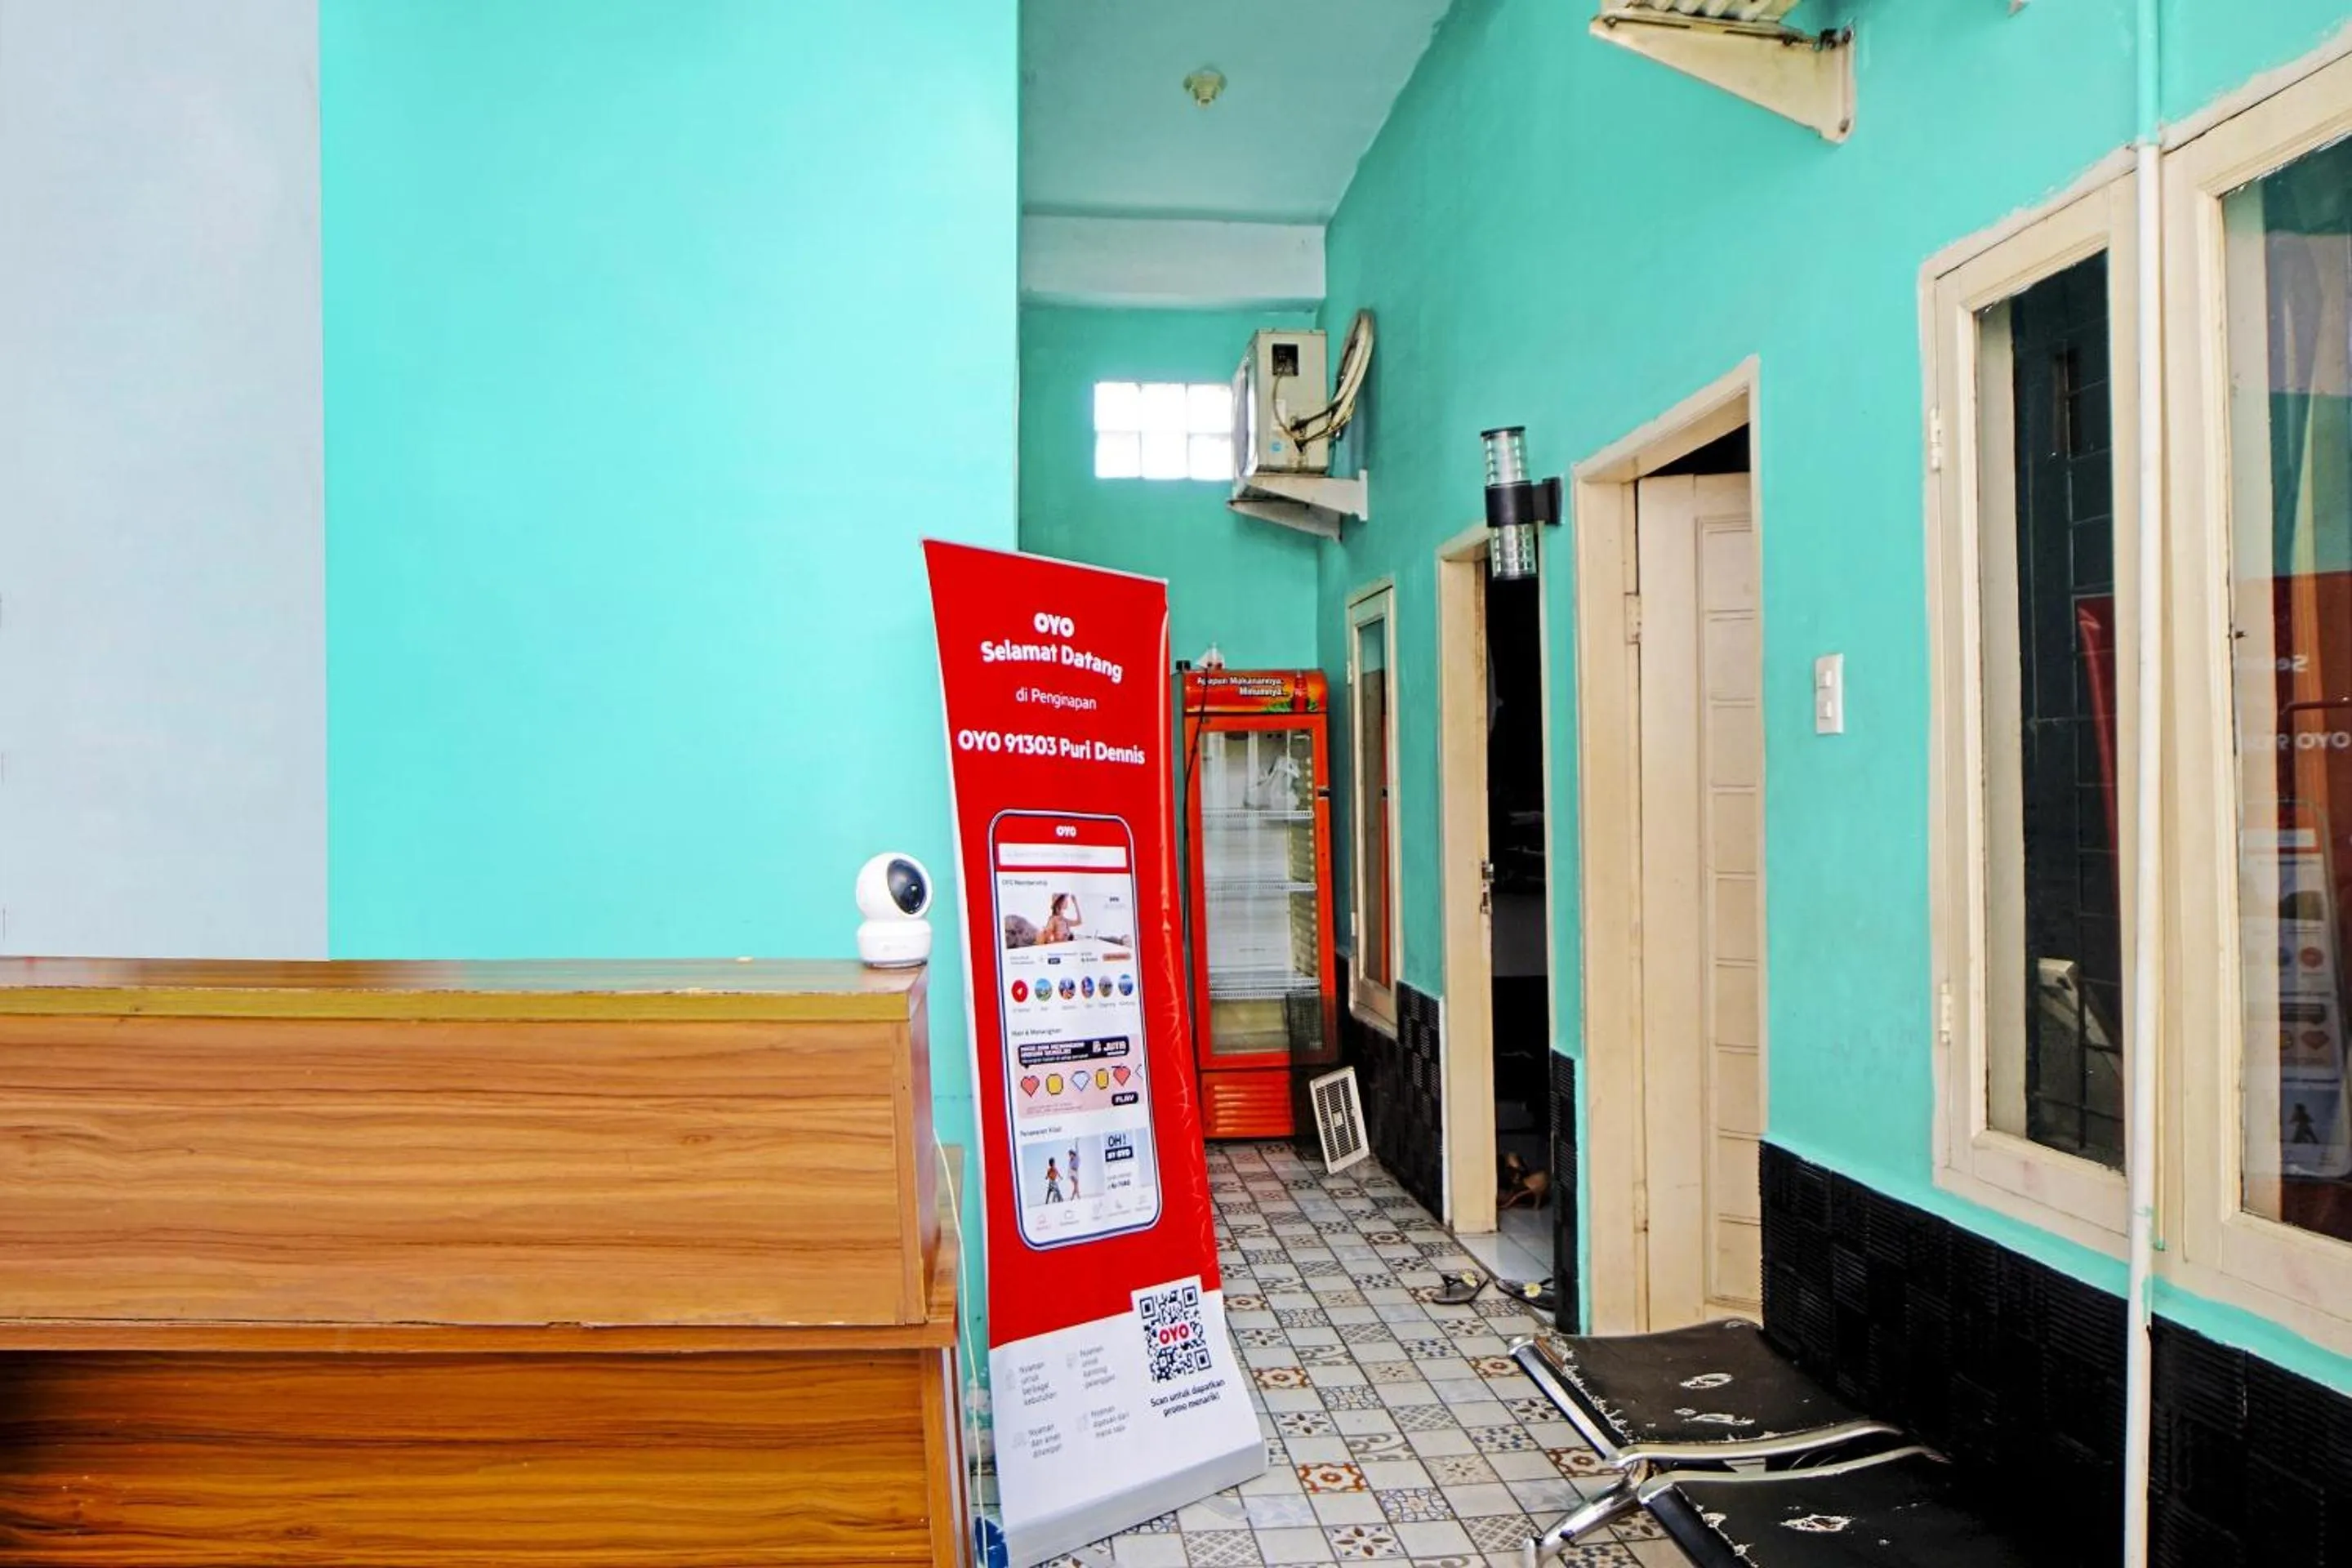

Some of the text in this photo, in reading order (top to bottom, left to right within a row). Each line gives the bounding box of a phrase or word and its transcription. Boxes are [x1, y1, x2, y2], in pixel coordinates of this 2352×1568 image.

[1033, 612, 1075, 638] OYO
[981, 639, 1123, 684] Selamat Datang
[1016, 688, 1097, 710] di Penginapan
[958, 729, 1145, 764] OYO 91303 Puri Dennis
[1056, 826, 1077, 837] OYO
[1160, 1324, 1189, 1344] OYO
[1150, 1396, 1169, 1407] Scan
[1169, 1388, 1191, 1401] untuk
